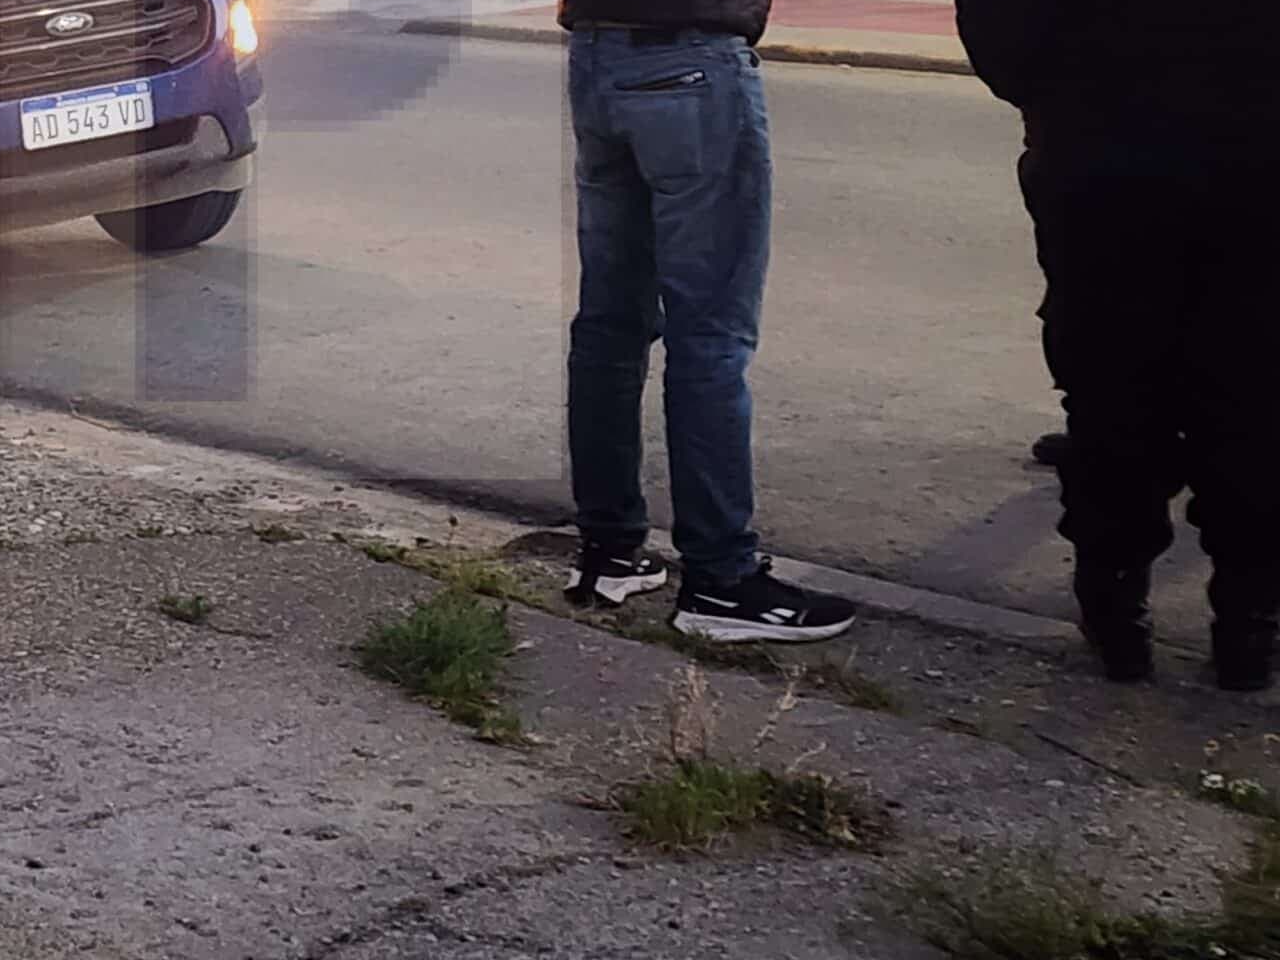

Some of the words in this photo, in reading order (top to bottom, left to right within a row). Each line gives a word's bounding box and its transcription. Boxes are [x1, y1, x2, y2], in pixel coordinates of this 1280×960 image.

[32, 113, 59, 143] AD
[66, 103, 110, 136] 543
[118, 97, 146, 126] VD
